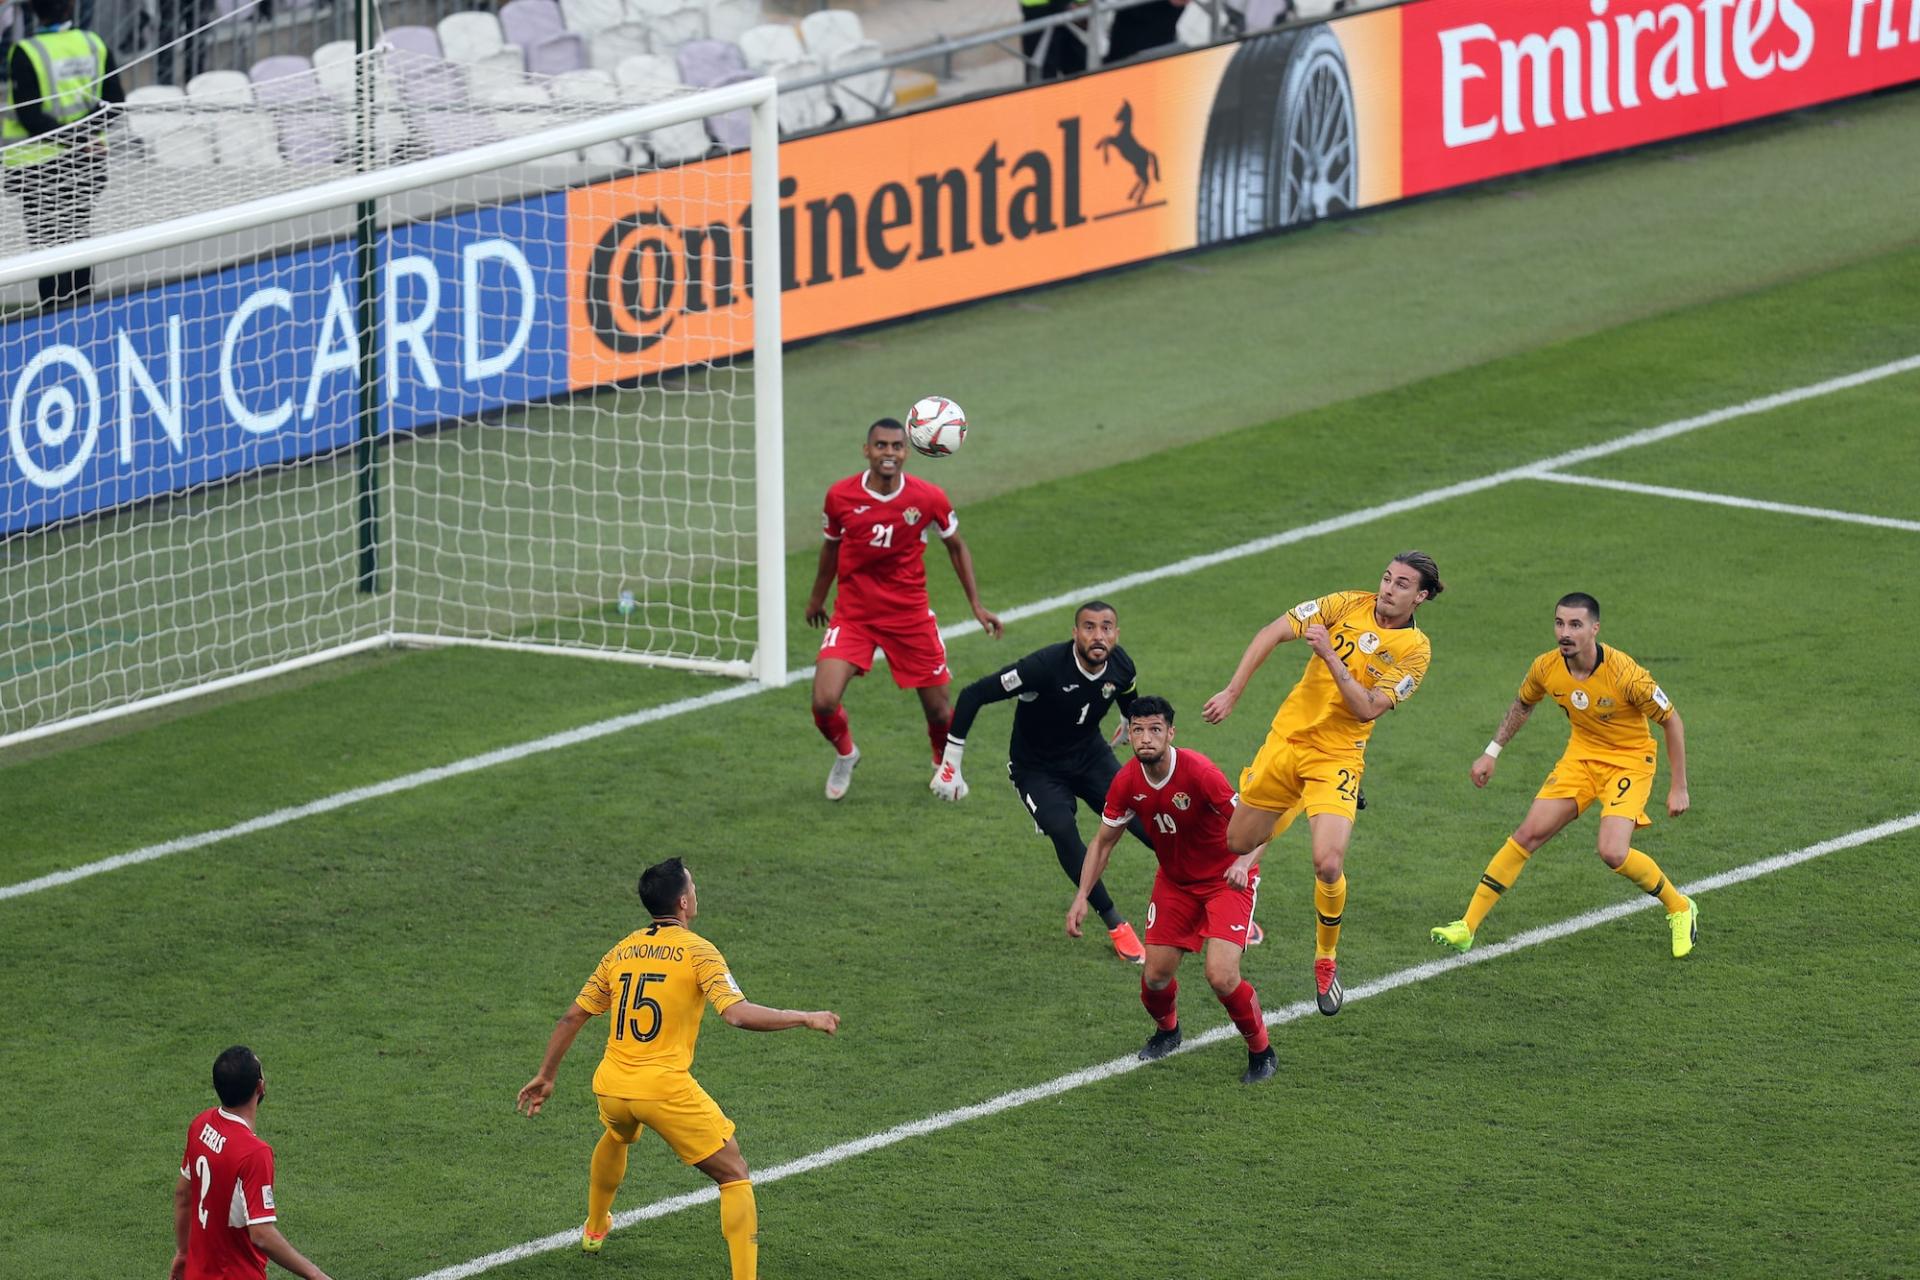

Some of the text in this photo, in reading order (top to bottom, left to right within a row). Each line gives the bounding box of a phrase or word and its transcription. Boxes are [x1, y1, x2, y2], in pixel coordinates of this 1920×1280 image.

[1438, 0, 1815, 148] Emirates
[220, 238, 537, 433] CARD
[869, 523, 894, 548] 21
[1334, 634, 1356, 668] 22
[1076, 702, 1090, 725] 1
[1617, 777, 1631, 799] 9
[1153, 812, 1177, 834] 19
[615, 972, 667, 1043] 15
[199, 1123, 227, 1154] FERAS
[195, 1155, 211, 1230] 2
